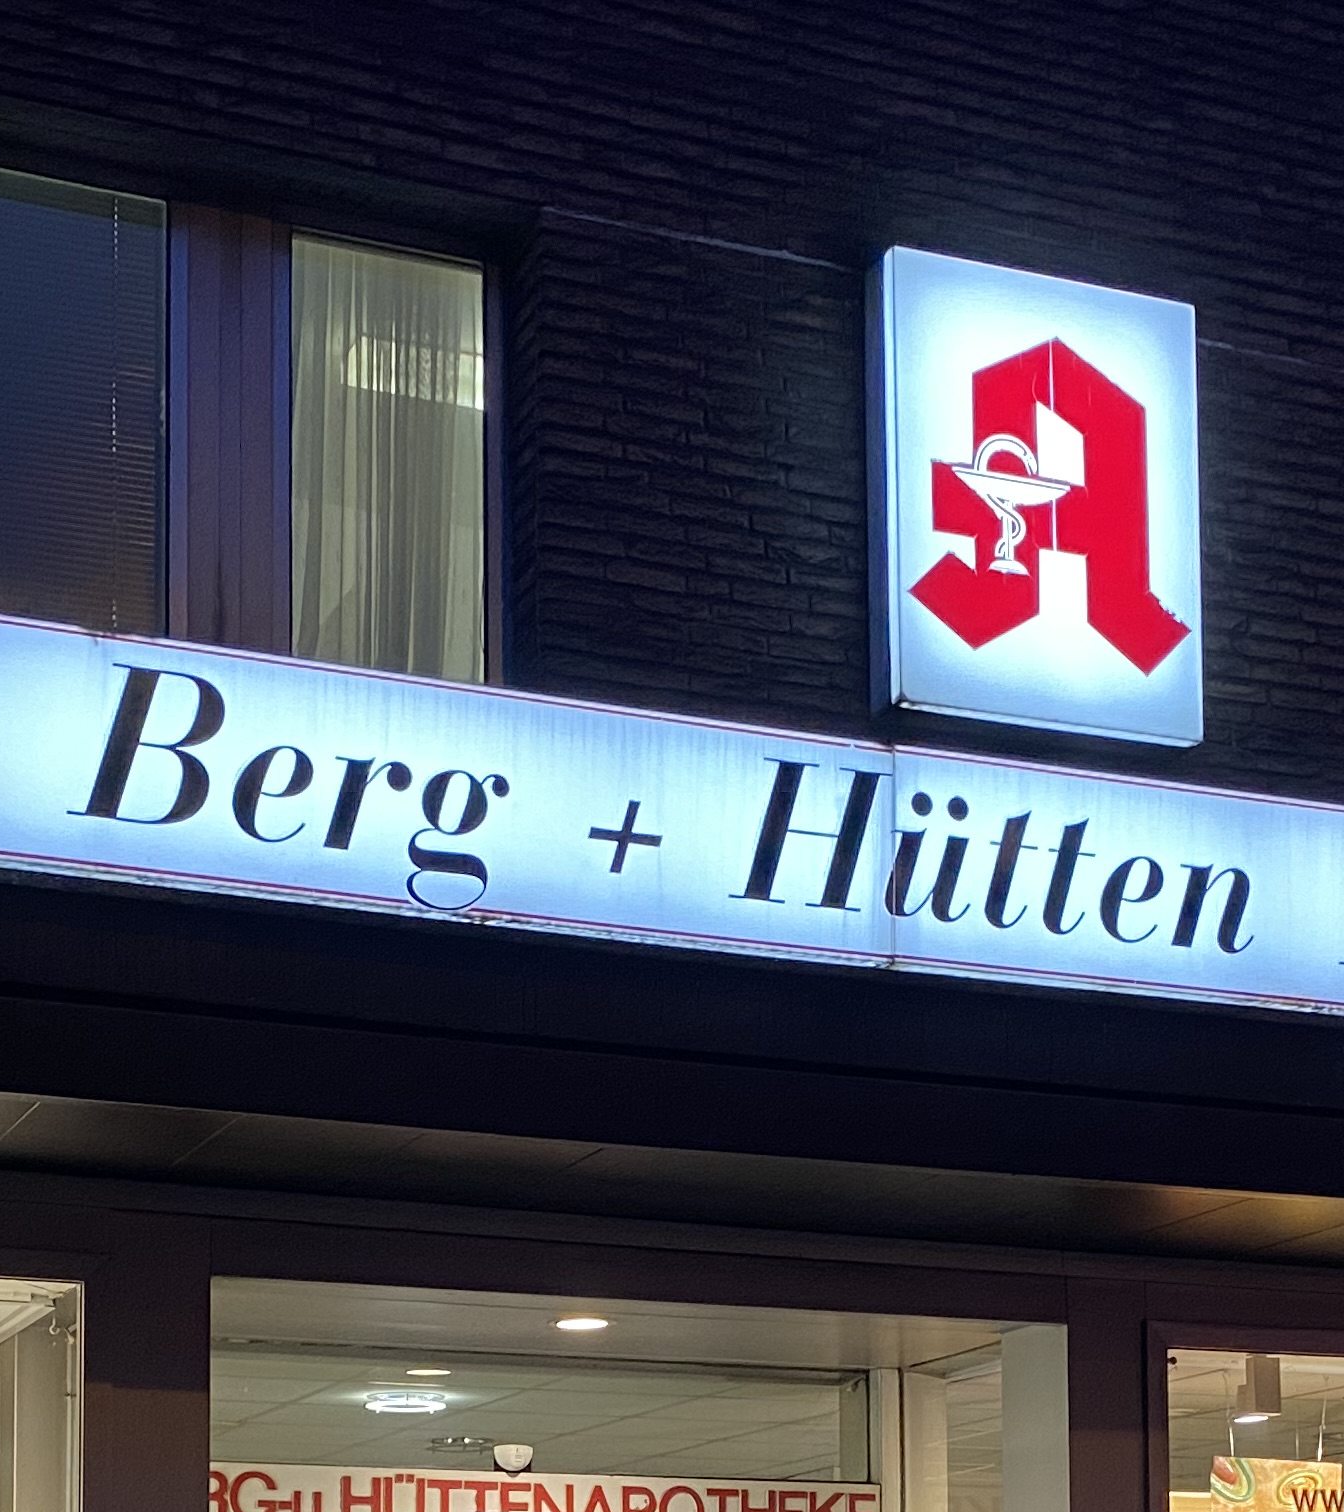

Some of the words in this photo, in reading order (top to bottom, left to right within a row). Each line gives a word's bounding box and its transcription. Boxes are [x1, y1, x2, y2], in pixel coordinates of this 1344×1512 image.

[68, 663, 510, 911] Berg
[588, 800, 663, 873] +
[729, 758, 1254, 955] Hütten
